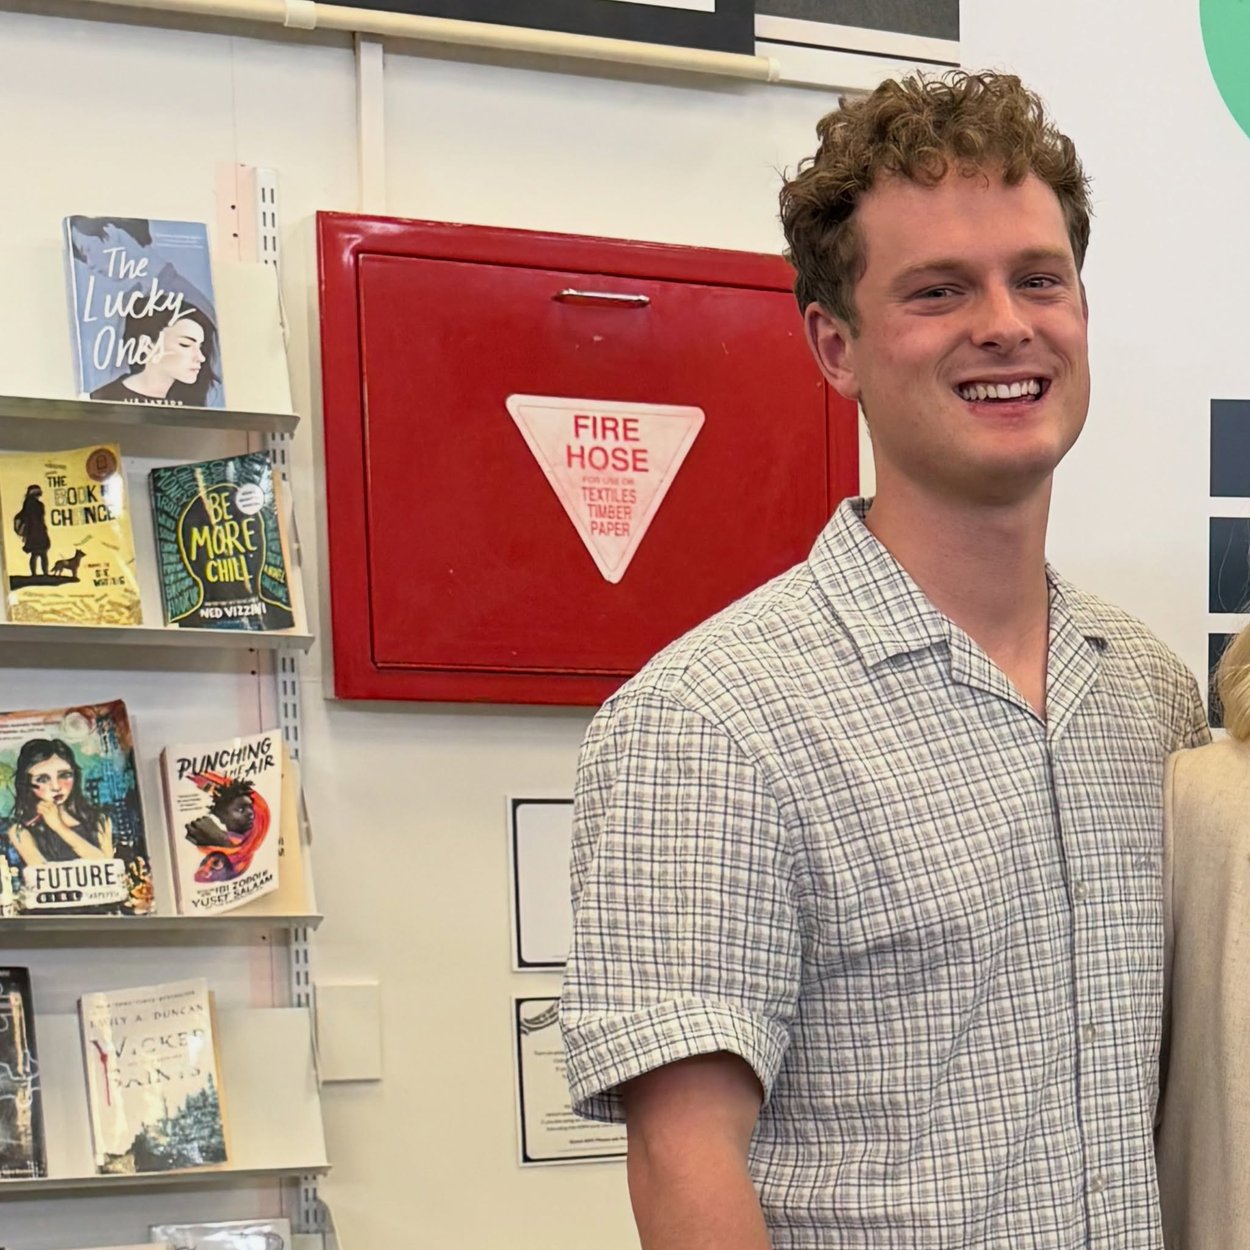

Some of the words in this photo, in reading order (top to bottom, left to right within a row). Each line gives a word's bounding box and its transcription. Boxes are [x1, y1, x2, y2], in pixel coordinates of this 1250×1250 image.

[103, 247, 149, 280] The
[83, 276, 196, 327] Lucky
[573, 415, 640, 441] FIRE
[566, 445, 649, 472] HOSE
[47, 476, 67, 487] THE
[209, 492, 234, 525] BE
[582, 487, 637, 504] TEXTILES
[51, 504, 116, 526] CHNCE
[588, 504, 632, 520] TIMBER
[191, 518, 257, 561] MORE
[590, 521, 630, 537] PAPER
[206, 554, 253, 582] CHILL
[200, 605, 223, 618] NED
[228, 602, 267, 618] VIZZINI
[177, 737, 272, 781] PUNCHING
[245, 755, 275, 778] AIR
[36, 863, 117, 889] FUTURE
